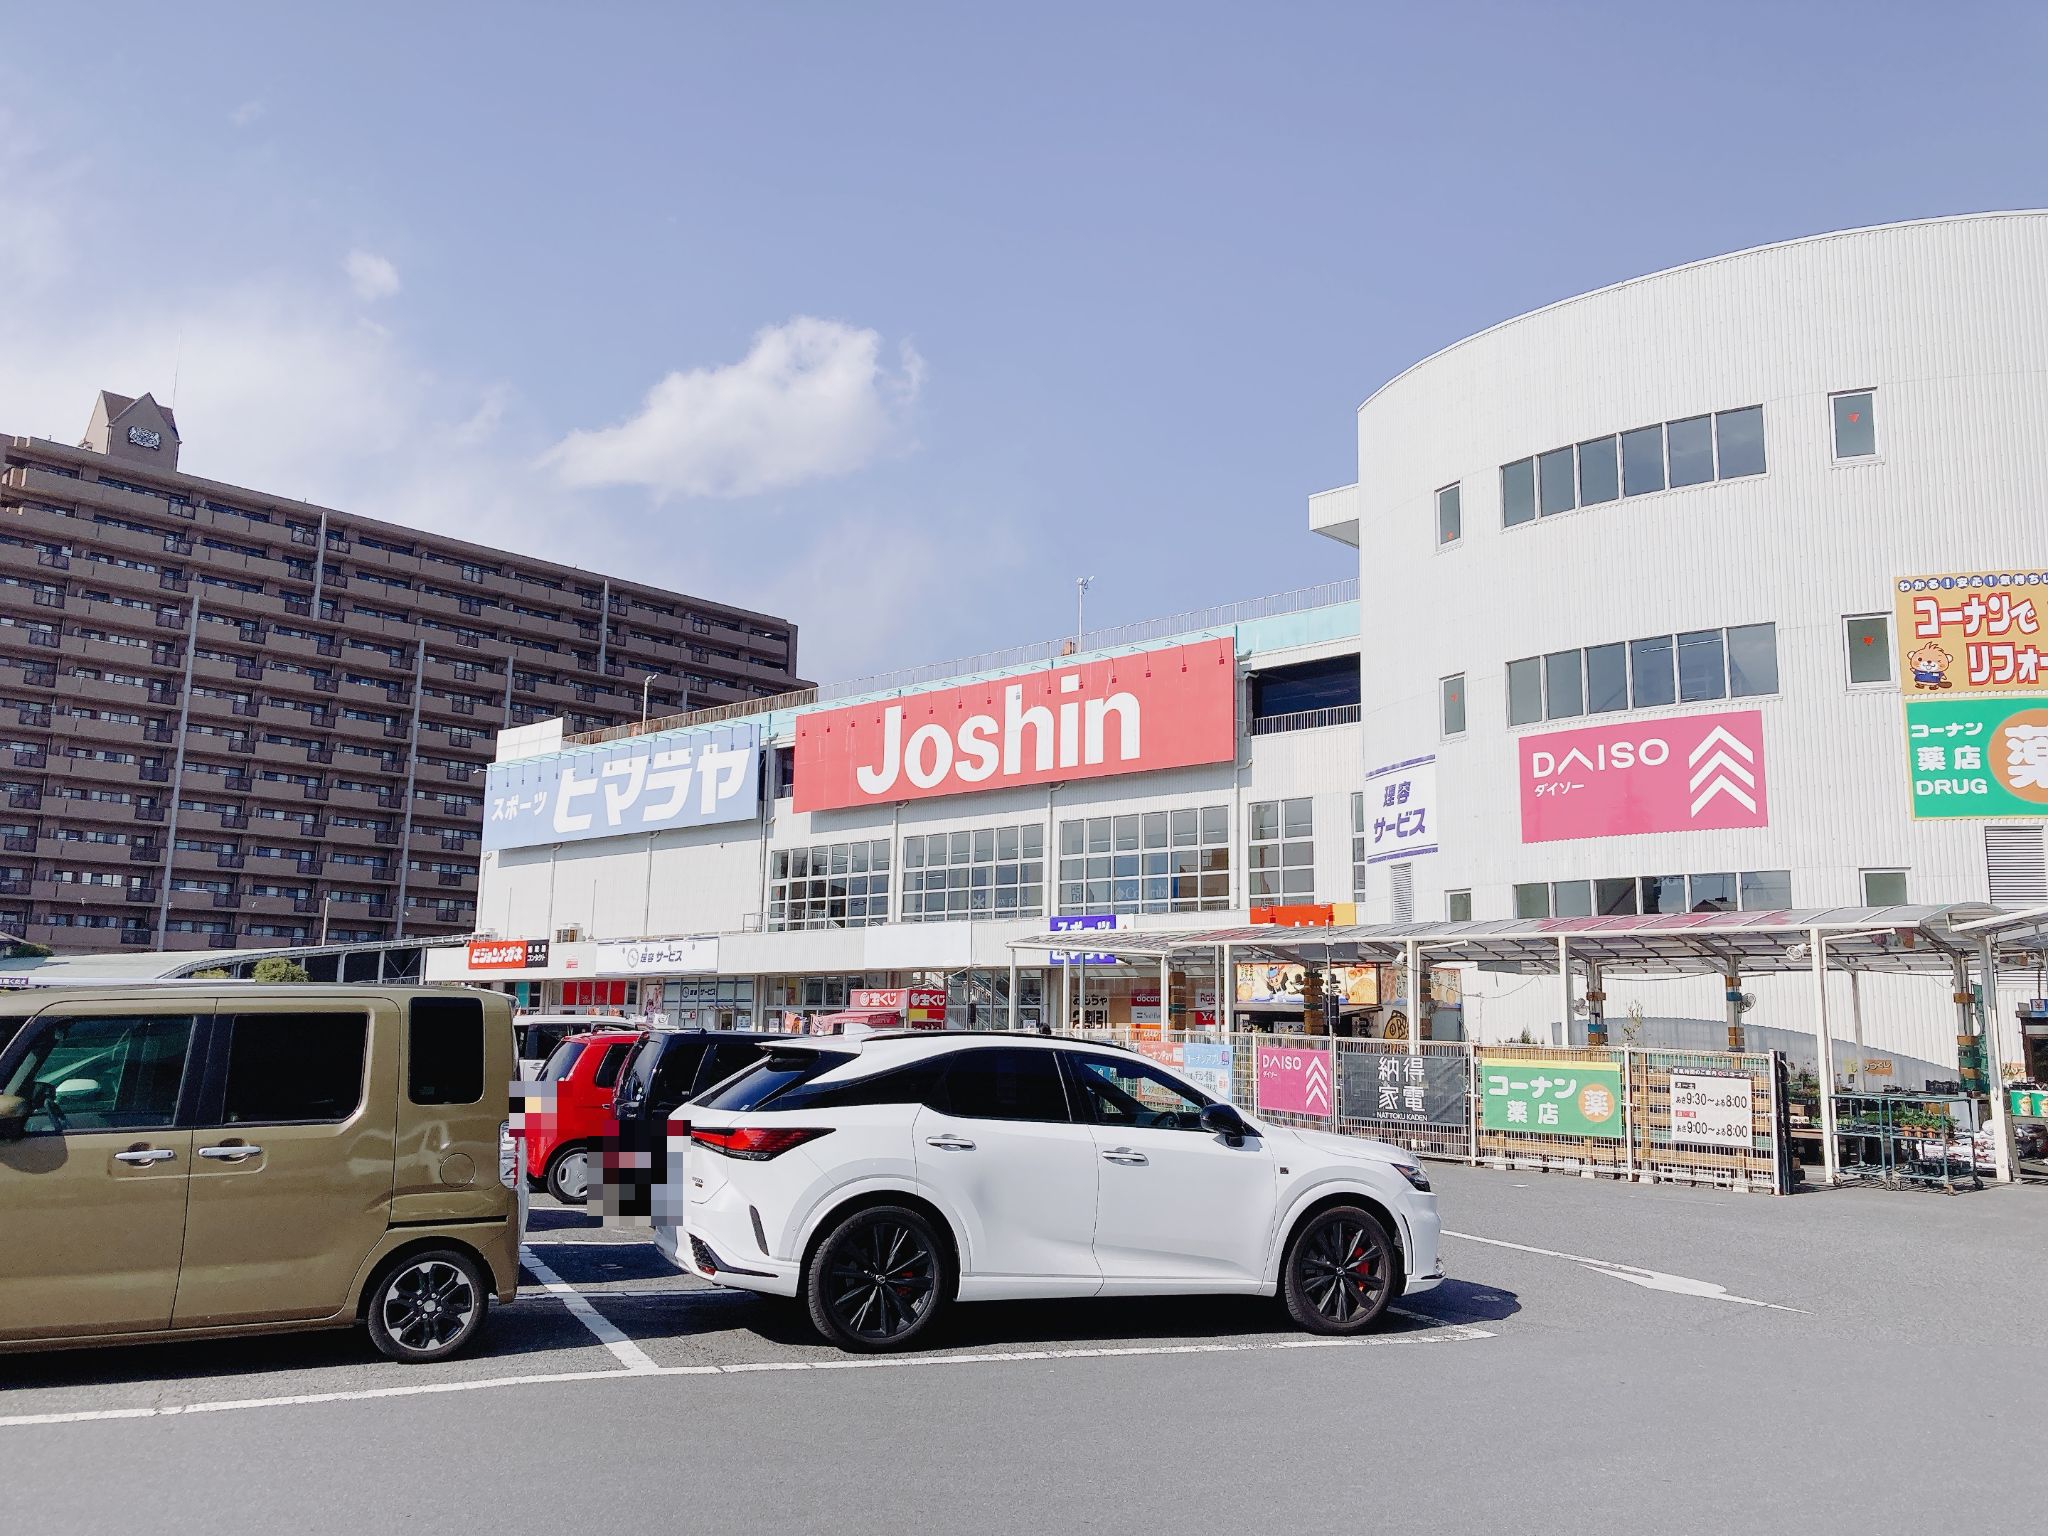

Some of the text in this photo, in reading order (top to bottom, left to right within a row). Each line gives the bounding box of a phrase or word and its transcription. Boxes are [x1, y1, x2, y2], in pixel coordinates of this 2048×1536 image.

[1913, 592, 2040, 639] コーナンで
[856, 674, 1140, 795] Joshin
[1911, 722, 1983, 739] コーナン
[1533, 738, 1670, 778] DAISO
[1916, 745, 1981, 771] 薬店
[2004, 724, 2048, 789] 薬
[553, 744, 752, 834] ヒマラヤ
[1383, 781, 1412, 808] 理容
[1534, 782, 1585, 798] ダイソー
[1916, 778, 1988, 796] DRUG
[491, 790, 548, 822] スポーツ
[1373, 807, 1426, 843] サービス
[656, 950, 683, 963] サービス
[869, 991, 897, 1006] 宝くじ
[919, 992, 945, 1006] 宝くじ
[1136, 993, 1160, 1002] docom
[1262, 1054, 1302, 1071] DAISO
[1378, 1056, 1425, 1083] 納得
[1378, 1086, 1425, 1112] 家電
[1488, 1075, 1577, 1099] コーナン
[1376, 1111, 1429, 1122] NATTOKU KADEN
[1507, 1100, 1559, 1125] 薬店
[1583, 1090, 1610, 1118] 薬
